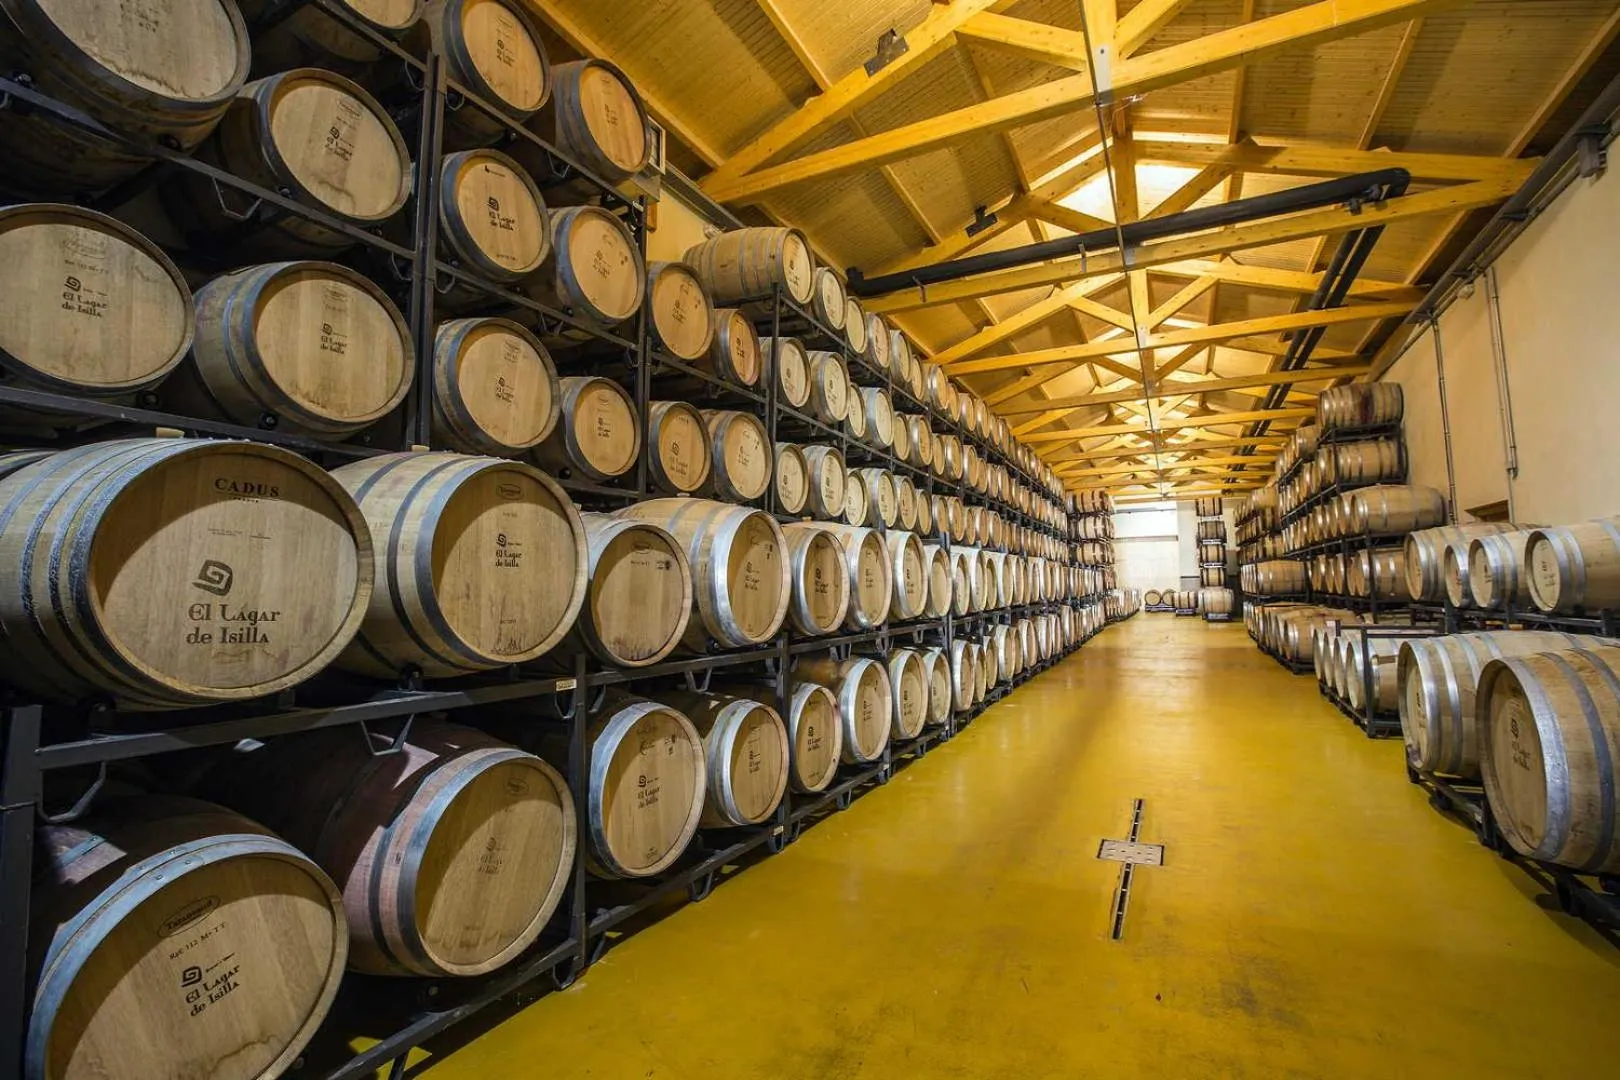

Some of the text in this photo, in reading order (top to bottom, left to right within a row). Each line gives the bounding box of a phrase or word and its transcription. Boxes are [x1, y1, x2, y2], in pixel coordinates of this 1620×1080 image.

[214, 478, 279, 497] CADUS
[188, 604, 211, 621] El
[186, 627, 269, 644] de Isilla
[185, 964, 240, 1004] El Lagar
[190, 981, 241, 1017] de Isilla
